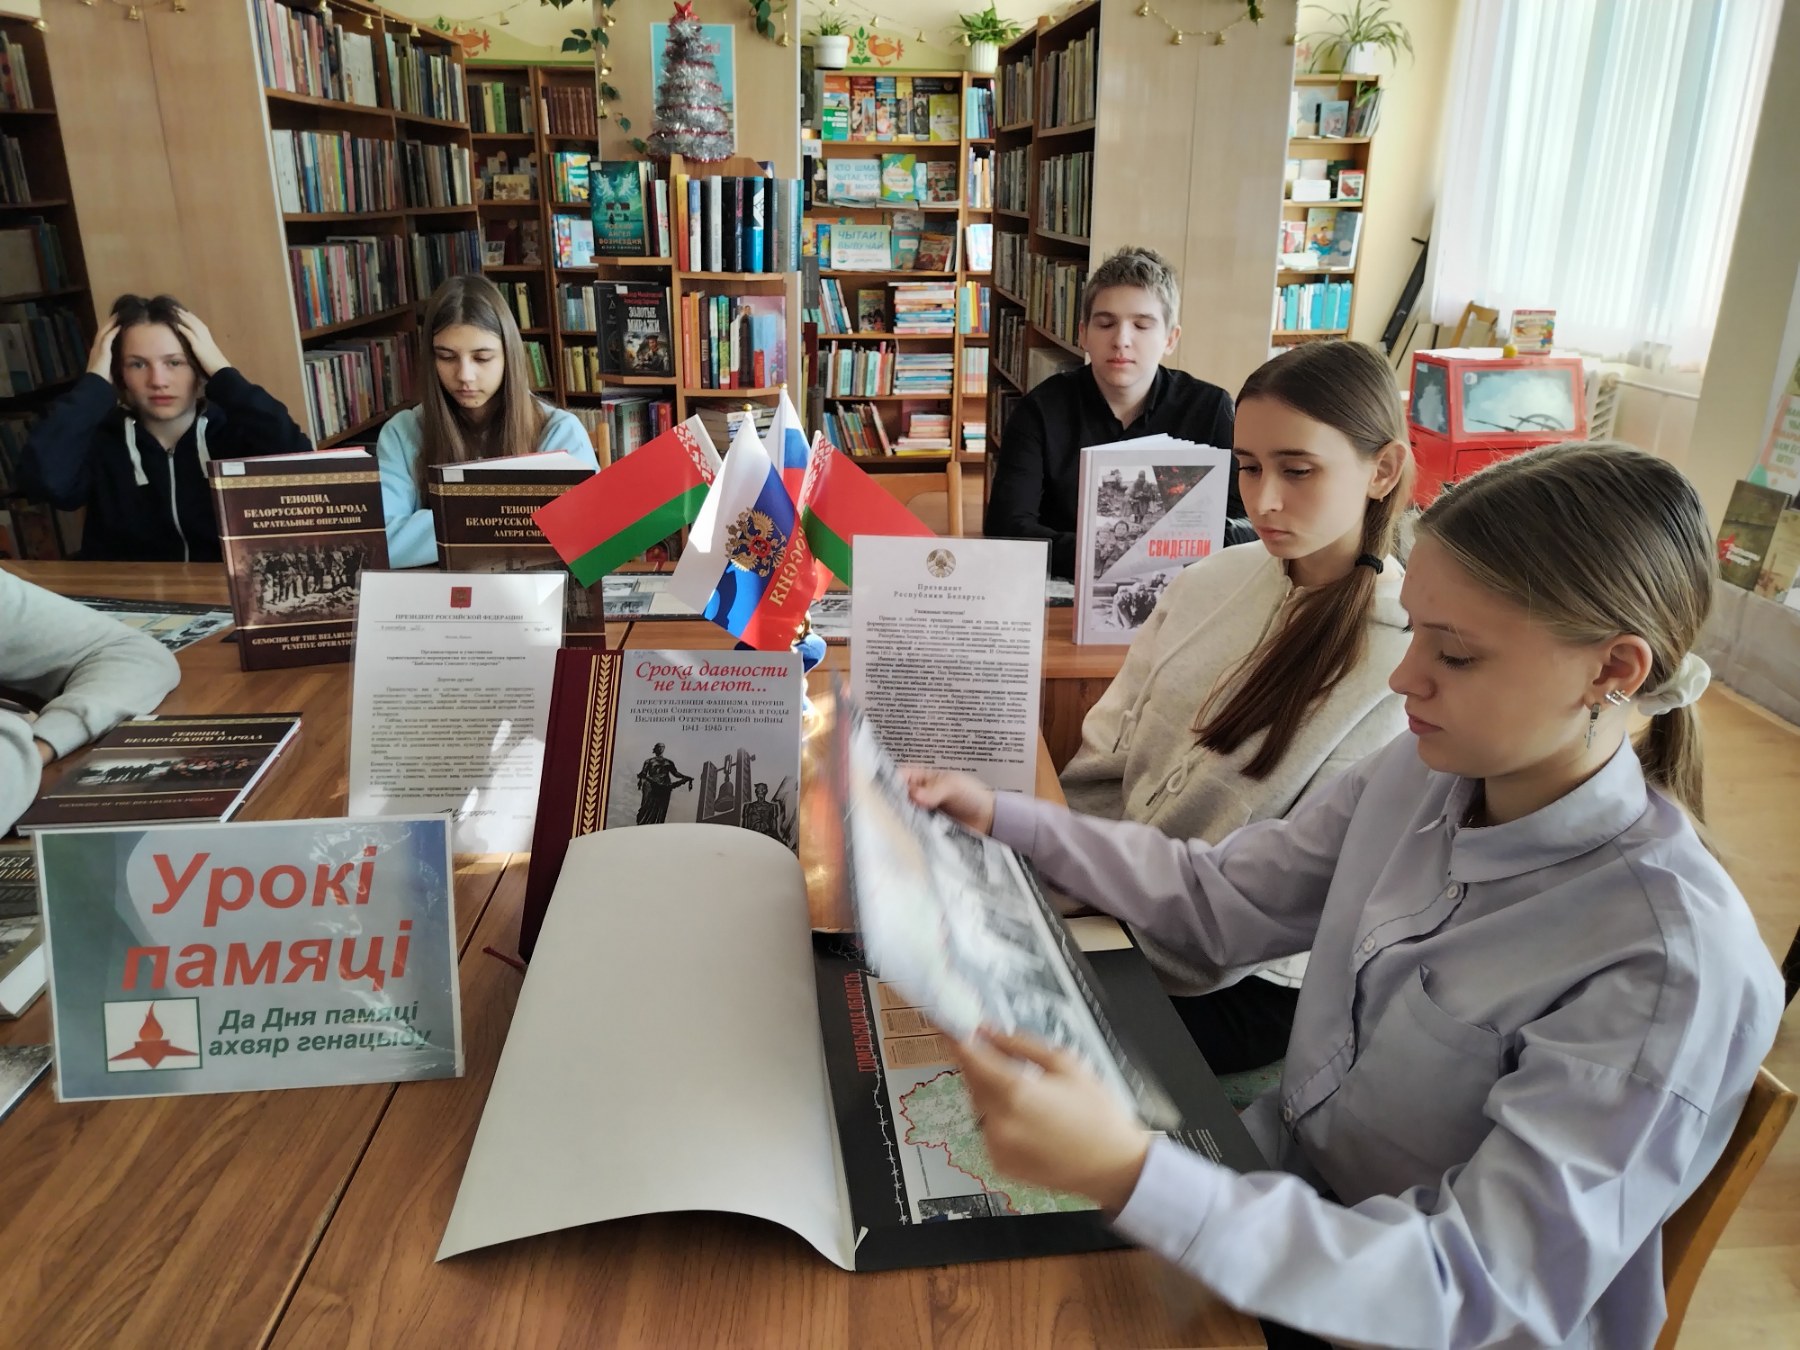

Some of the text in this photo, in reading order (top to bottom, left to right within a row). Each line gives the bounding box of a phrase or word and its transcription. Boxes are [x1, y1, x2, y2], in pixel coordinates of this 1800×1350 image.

[627, 318, 660, 332] МИРАЖИ
[280, 494, 330, 504] ГЕНОЦИД
[244, 504, 368, 518] БЕЛОРУССКОГО НАРОДА
[500, 505, 541, 514] ГЕНОЦИ
[252, 516, 362, 529] КАРАТЕЛЬНЫЕ ОПЕРАЦИИ
[465, 517, 539, 526] БЕЛОРУССКОГ
[1148, 539, 1212, 560] СВИДЕТЕЛИ
[917, 583, 963, 592] Президент
[893, 591, 986, 601] Республики Беларусь
[435, 612, 482, 621] РОССИЙСКОЙ
[483, 614, 524, 622] ФЕДЕРАЦИИ
[252, 636, 290, 645] GENOCIDE
[290, 635, 301, 643] OF
[302, 634, 318, 642] THE
[281, 642, 317, 651] PUNITIVE
[635, 659, 788, 681] Срока давности
[654, 679, 767, 692] не имеют...
[753, 715, 784, 723] ВОЙНЫ
[152, 845, 378, 928] Урокі
[121, 919, 413, 992] памяці
[218, 1001, 418, 1035] Да Дня памяці
[843, 972, 878, 1073] ГОМЕЛЬСКАЯ ОБЛАСТЬ
[209, 1025, 432, 1058] ахвяр генацыду
